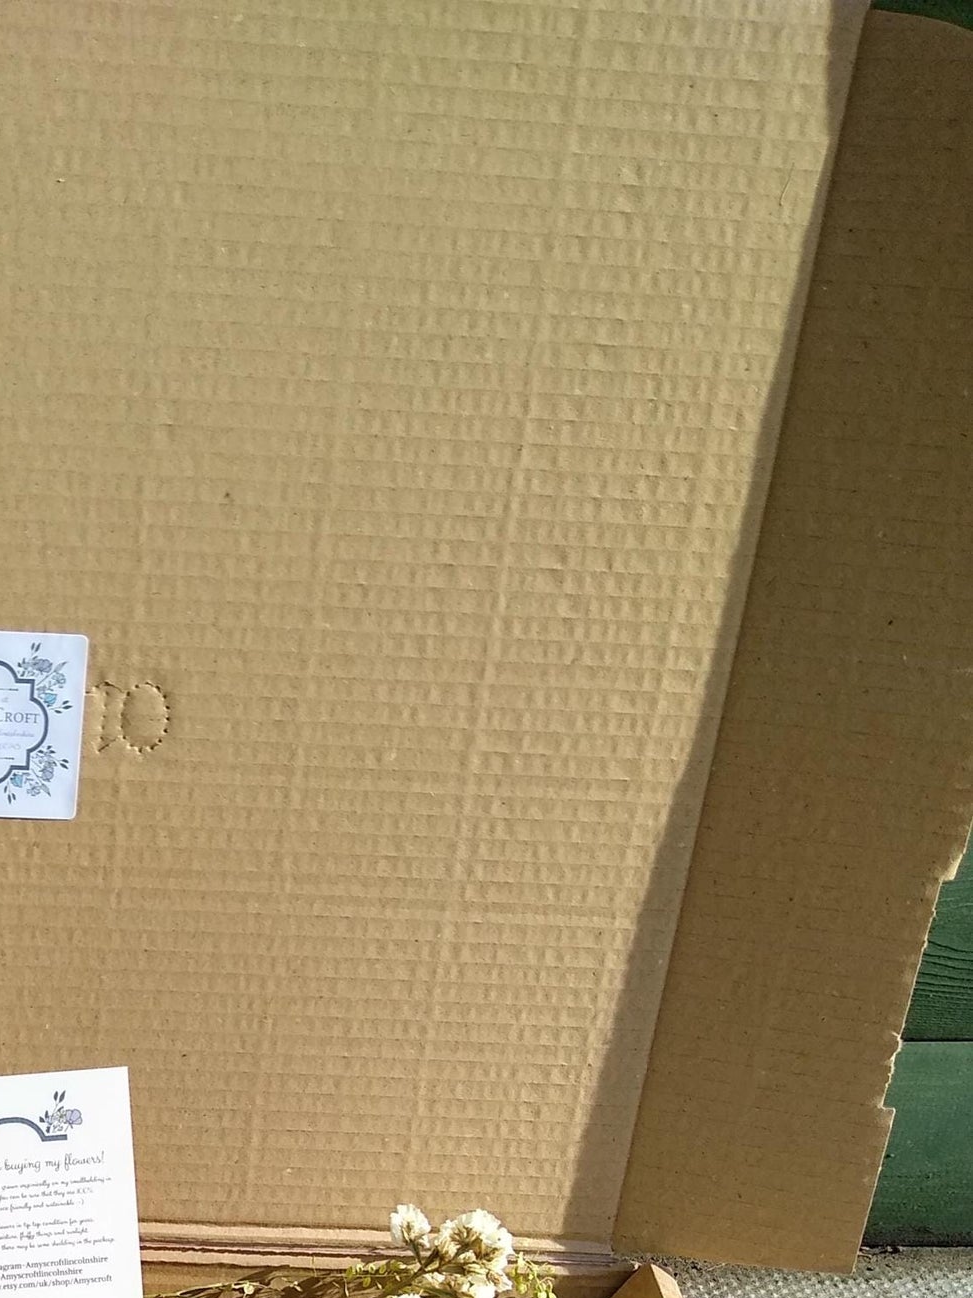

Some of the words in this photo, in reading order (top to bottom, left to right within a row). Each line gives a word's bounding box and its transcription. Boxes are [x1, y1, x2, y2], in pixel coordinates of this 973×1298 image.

[4, 1159, 41, 1175] buying
[45, 1160, 60, 1172] my
[64, 1150, 104, 1172] flowers!
[10, 1202, 32, 1212] friendly
[20, 1231, 34, 1240] fluffy
